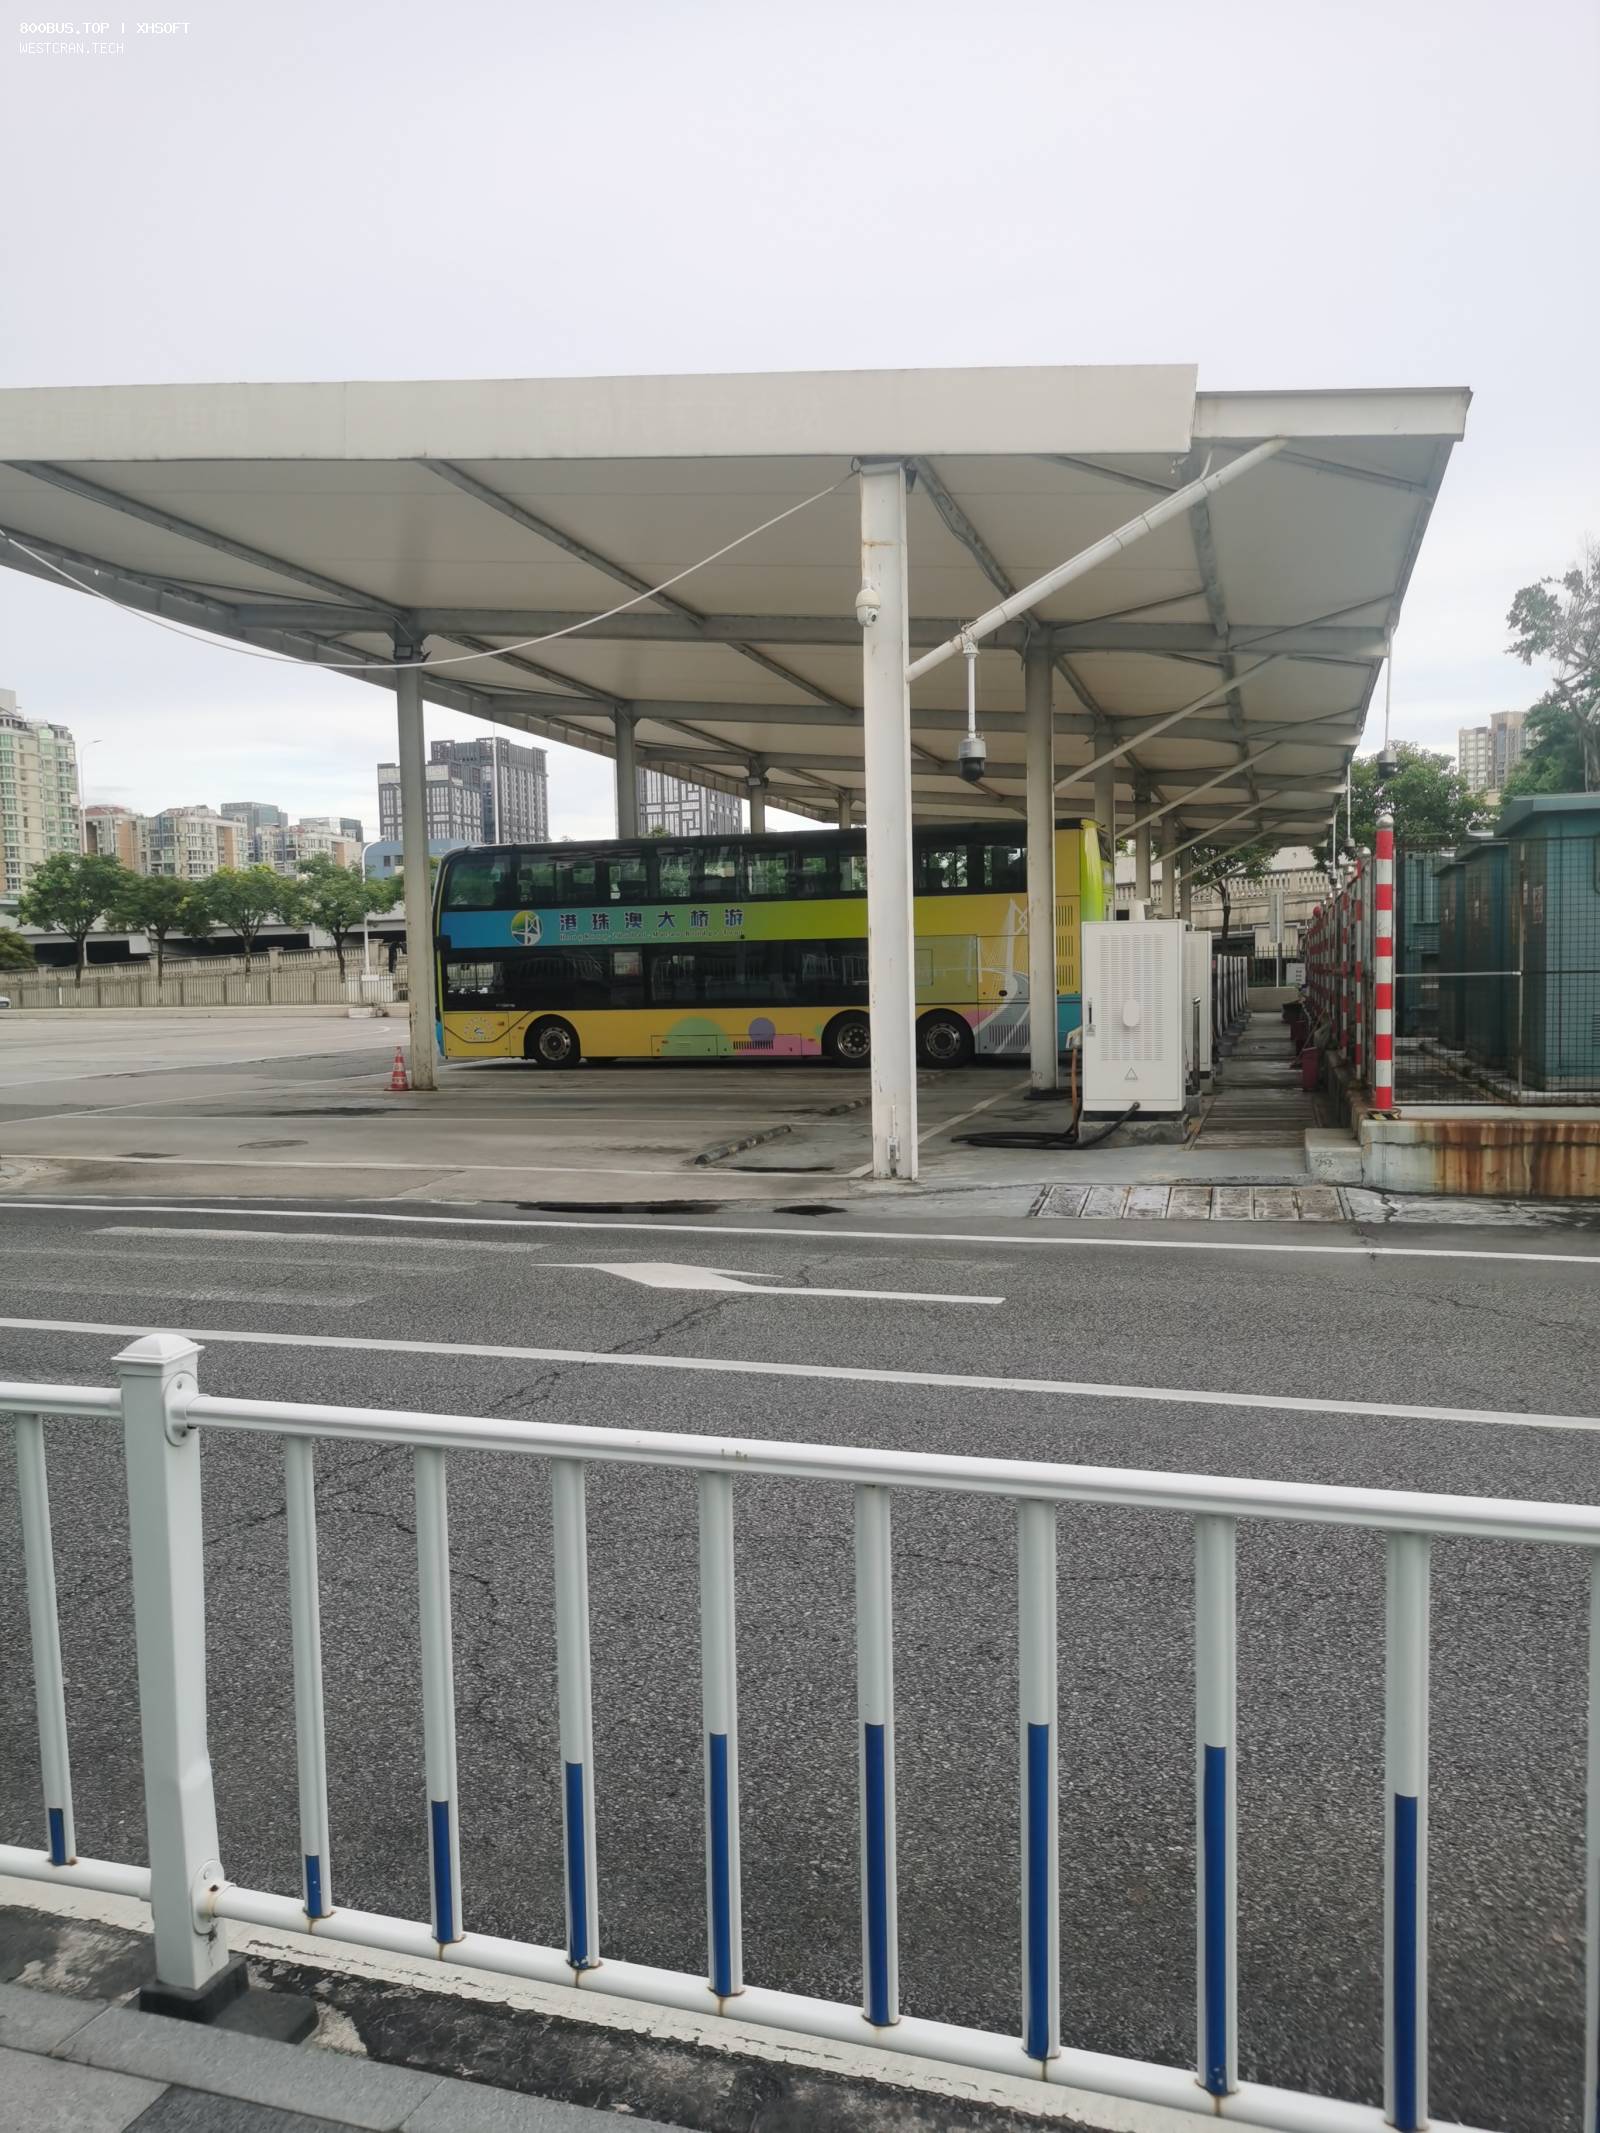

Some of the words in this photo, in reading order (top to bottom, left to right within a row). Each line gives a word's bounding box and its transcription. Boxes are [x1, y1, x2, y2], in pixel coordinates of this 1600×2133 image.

[559, 908, 744, 931] 港珠澳大桥游
